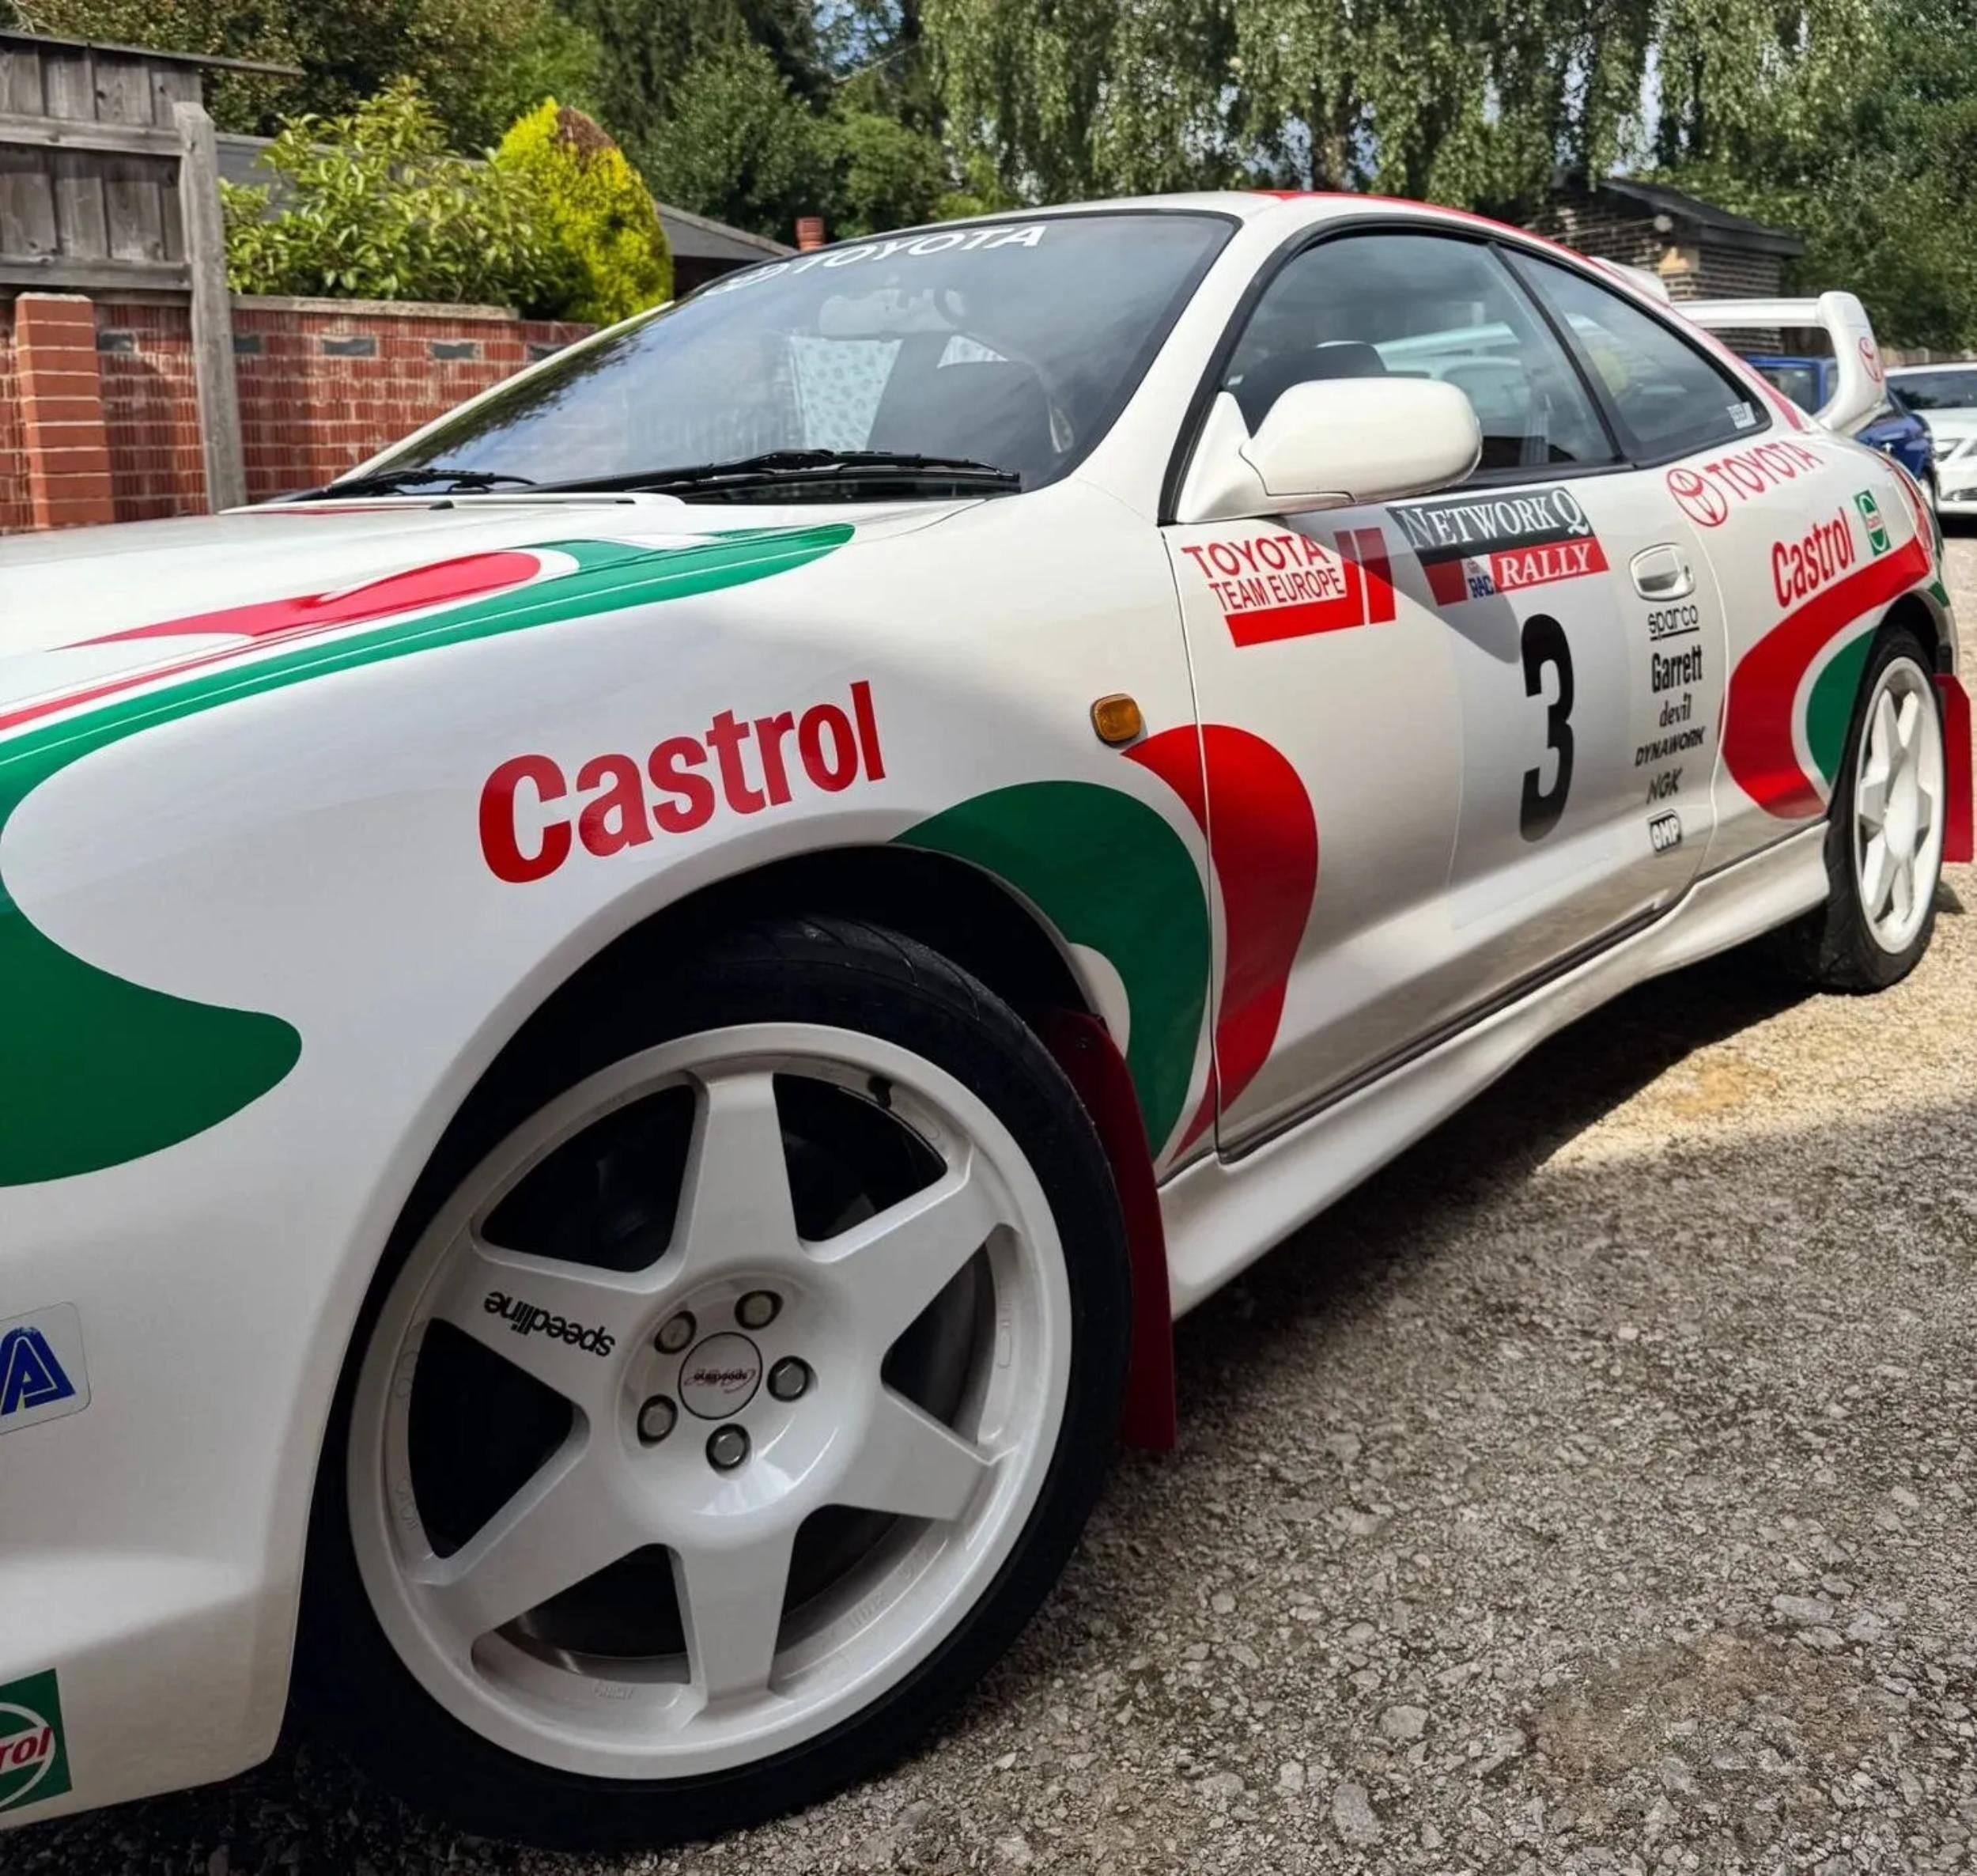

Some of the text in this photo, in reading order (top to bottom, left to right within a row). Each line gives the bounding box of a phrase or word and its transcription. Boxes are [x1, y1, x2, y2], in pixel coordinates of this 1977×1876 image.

[792, 225, 1049, 274] TOYOTA
[1704, 441, 1824, 500] TOYOTA
[1396, 489, 1590, 549] NETWORK Q
[1181, 535, 1331, 579] TOYOTA
[1499, 543, 1592, 588] RALLY
[1771, 509, 1856, 609] Castrol
[1209, 568, 1345, 612] TEAM EUROPE
[1468, 575, 1495, 599] RAC
[1647, 605, 1699, 641] sparco
[1652, 645, 1703, 694] Garrett
[1520, 614, 1574, 842] 3
[1659, 692, 1692, 727] devil
[1635, 726, 1706, 767] DYNAWORK
[478, 680, 886, 884] Castrol
[1646, 768, 1683, 804] NGK
[1651, 816, 1680, 849] OMP
[484, 1291, 616, 1358] speedline
